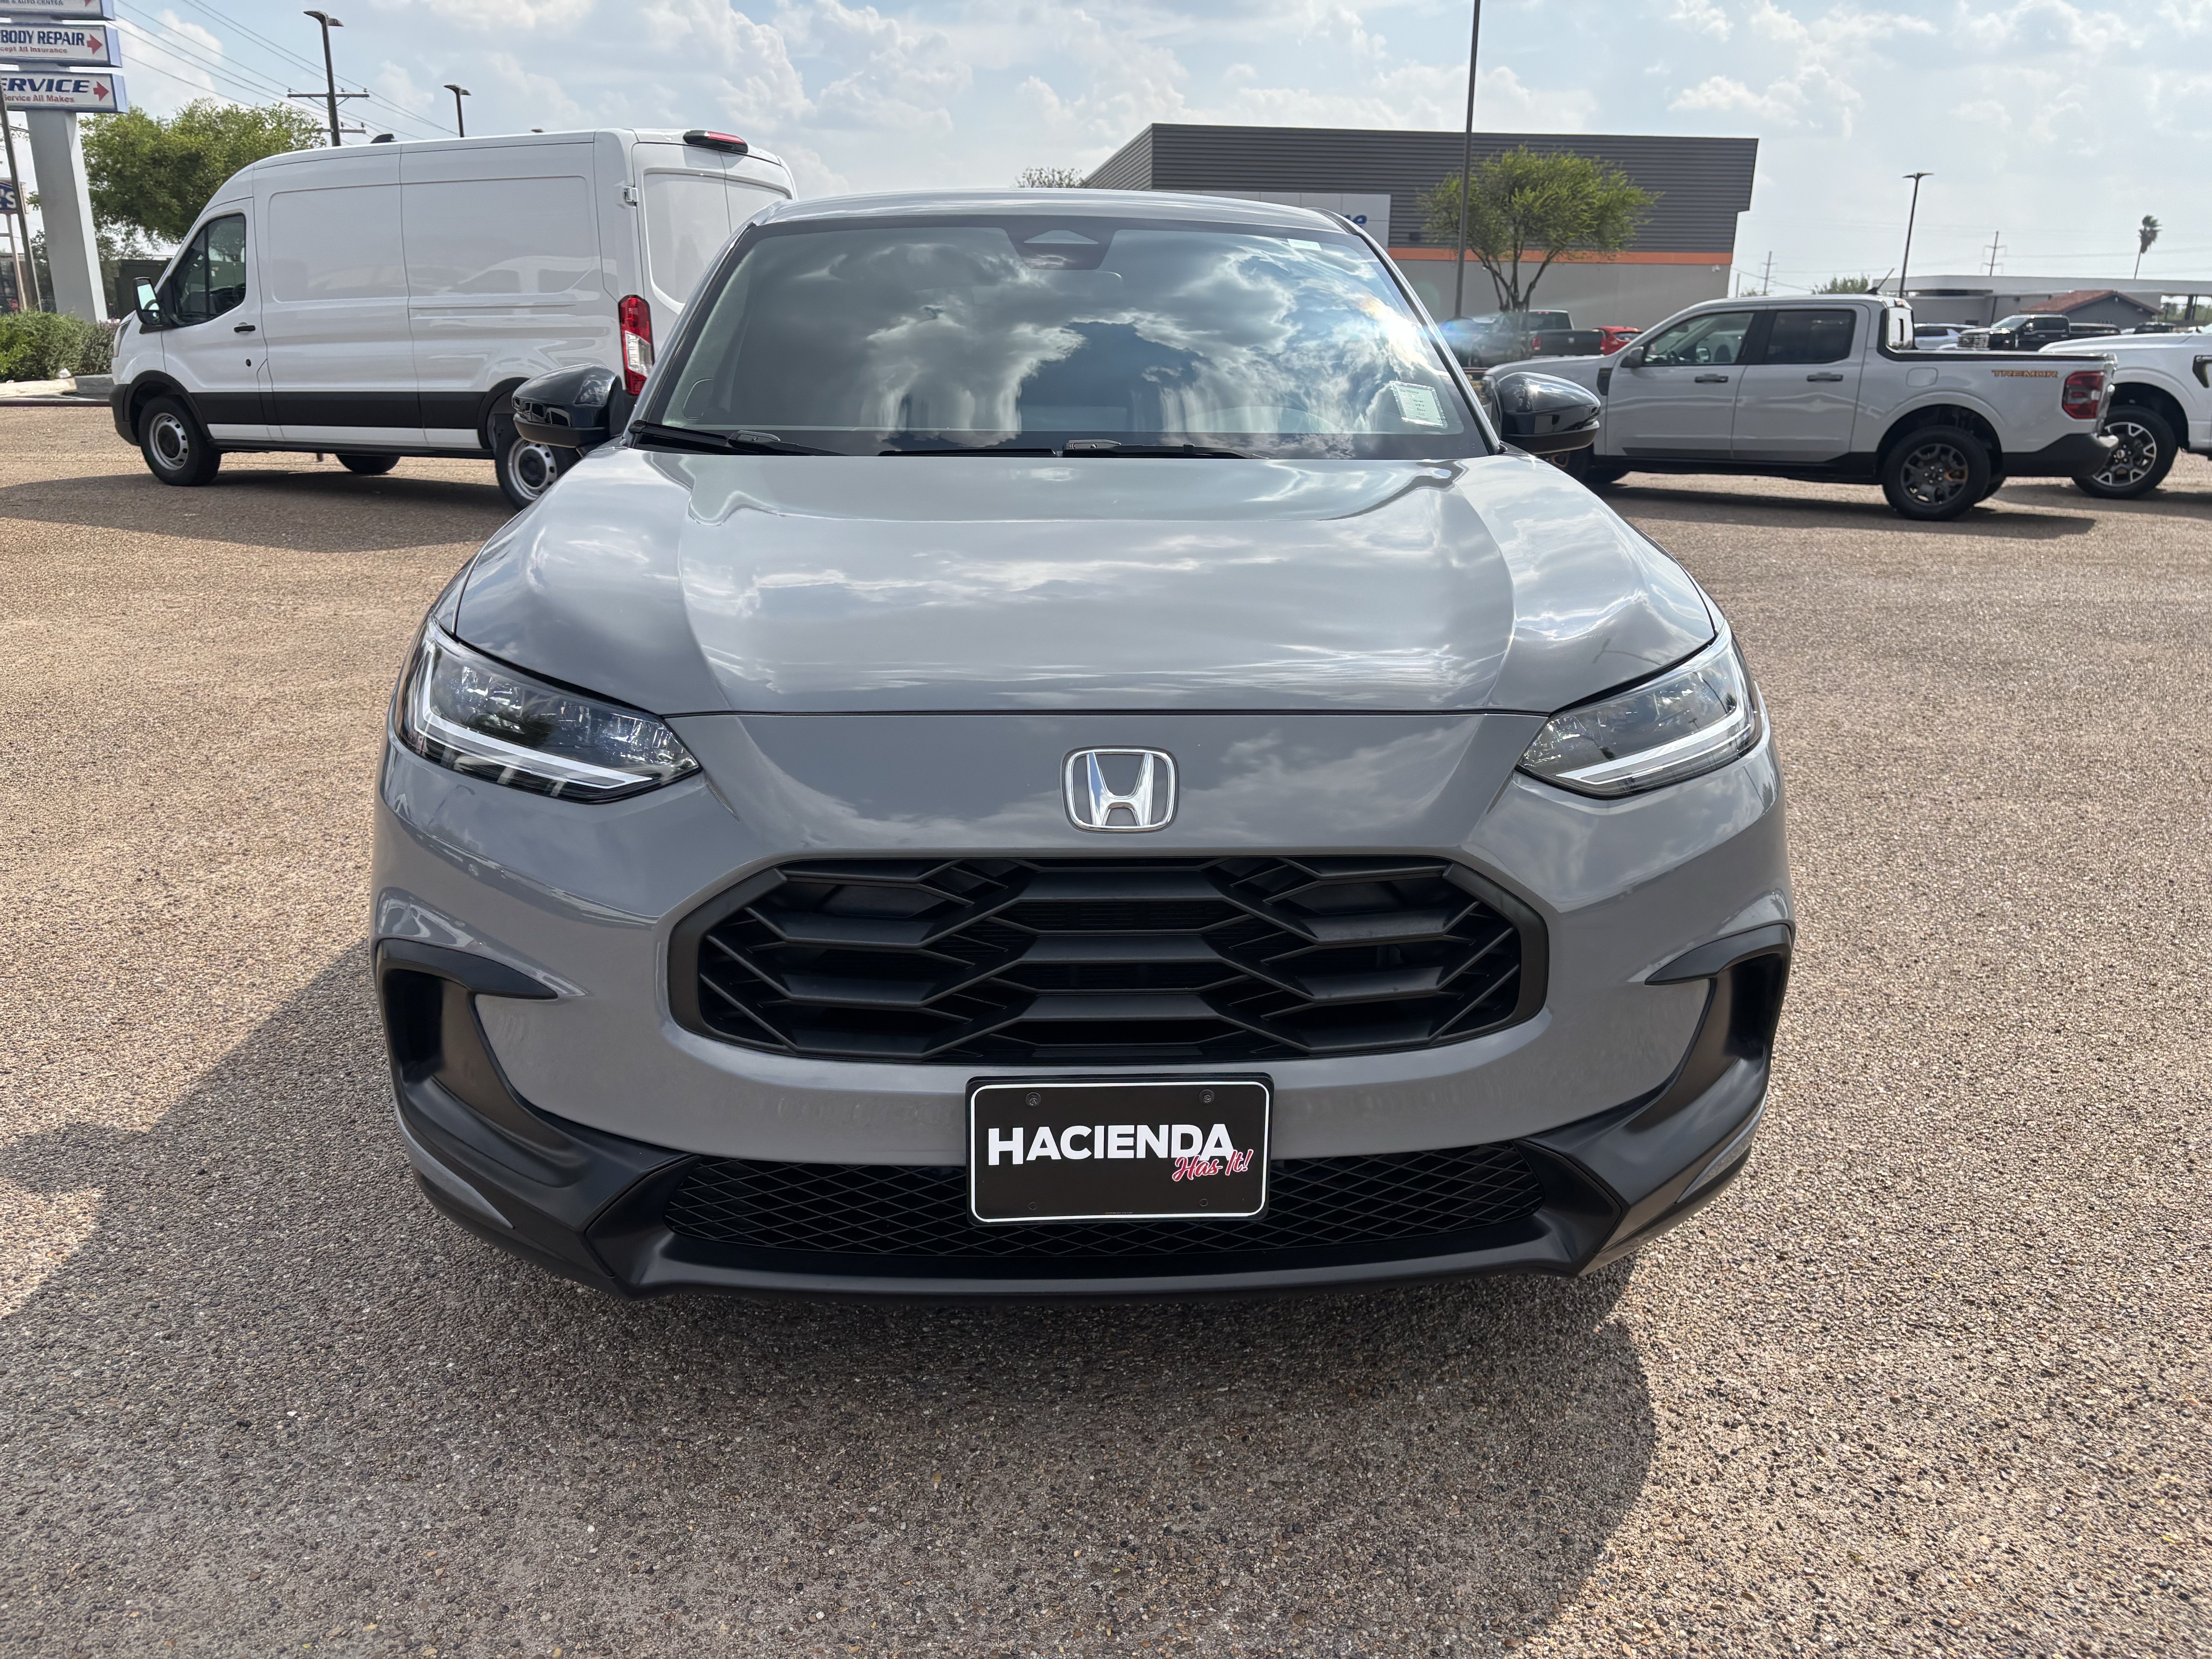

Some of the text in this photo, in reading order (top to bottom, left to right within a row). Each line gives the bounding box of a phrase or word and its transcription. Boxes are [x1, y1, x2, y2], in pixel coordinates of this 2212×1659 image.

[0, 30, 84, 46] BODY REPAIR
[1991, 369, 2058, 378] TREMOR
[988, 1123, 1235, 1166] HACIENDA
[1172, 1149, 1254, 1182] Has It!
